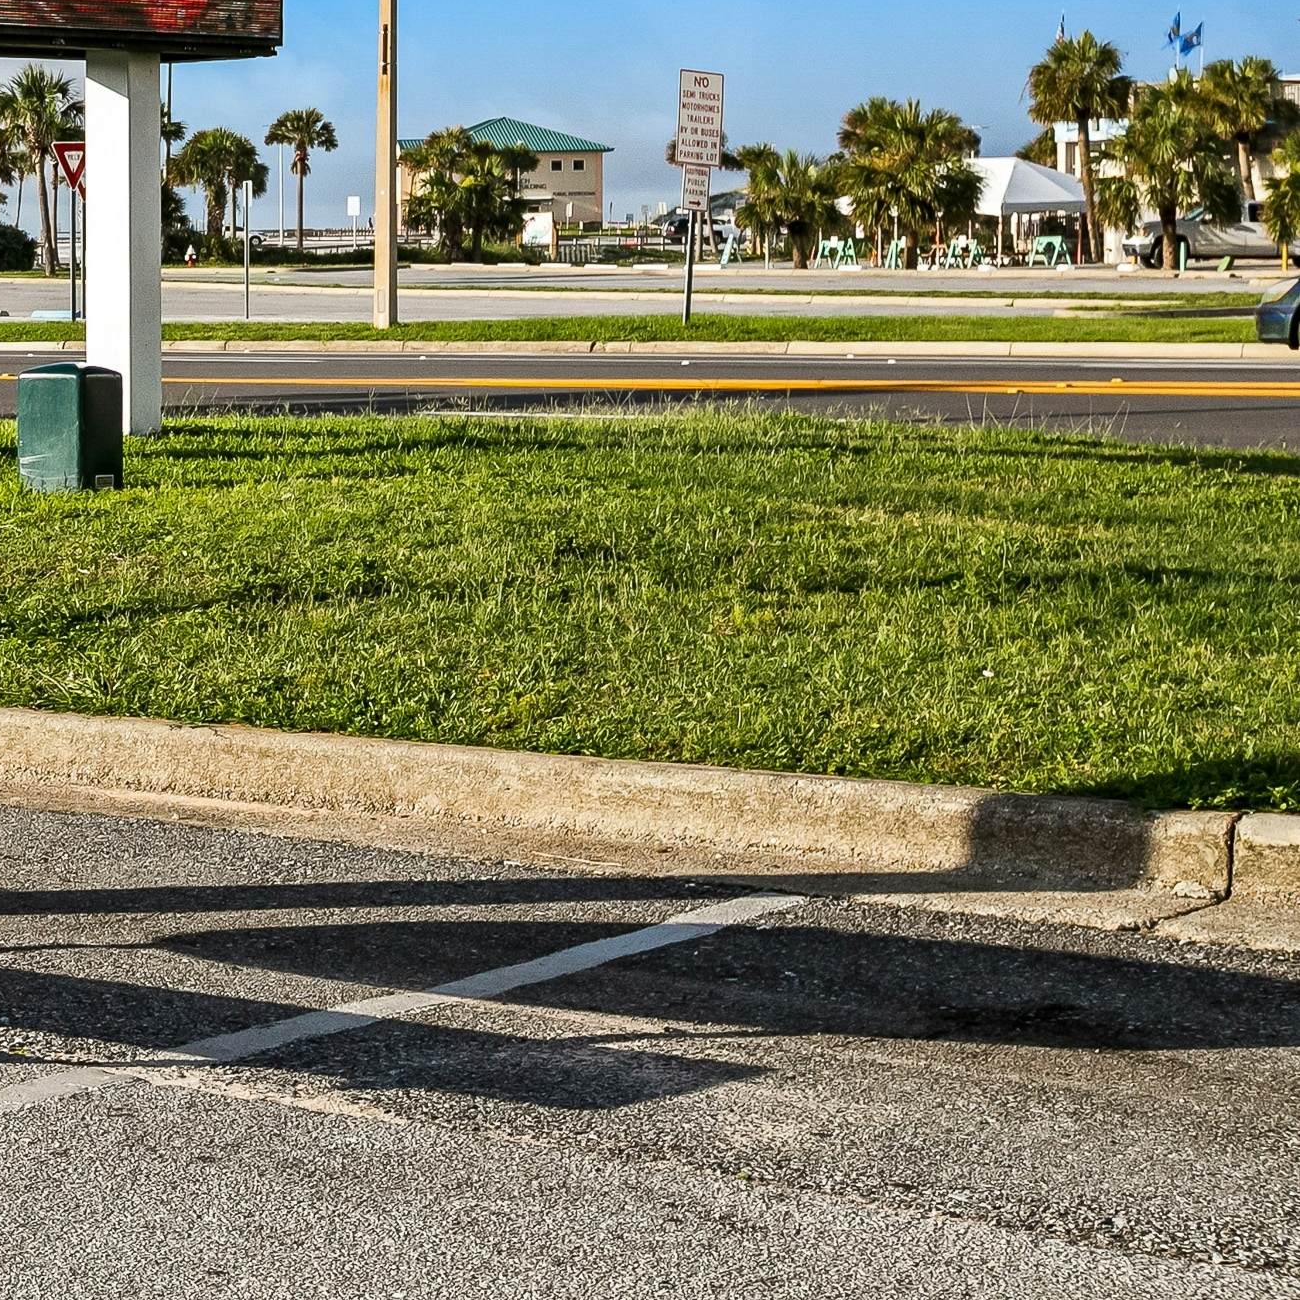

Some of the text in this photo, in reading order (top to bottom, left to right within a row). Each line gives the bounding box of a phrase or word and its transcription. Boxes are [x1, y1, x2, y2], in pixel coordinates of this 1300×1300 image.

[694, 76, 710, 88] NO
[699, 91, 720, 102] TRUCKS
[682, 101, 720, 113] MOTORHOMES
[687, 114, 714, 125] TRAILERS
[701, 128, 719, 138] BUSES
[681, 138, 718, 150] ALLOWED IN
[679, 149, 718, 161] PARKING LOT
[687, 178, 706, 187] PUBLIC
